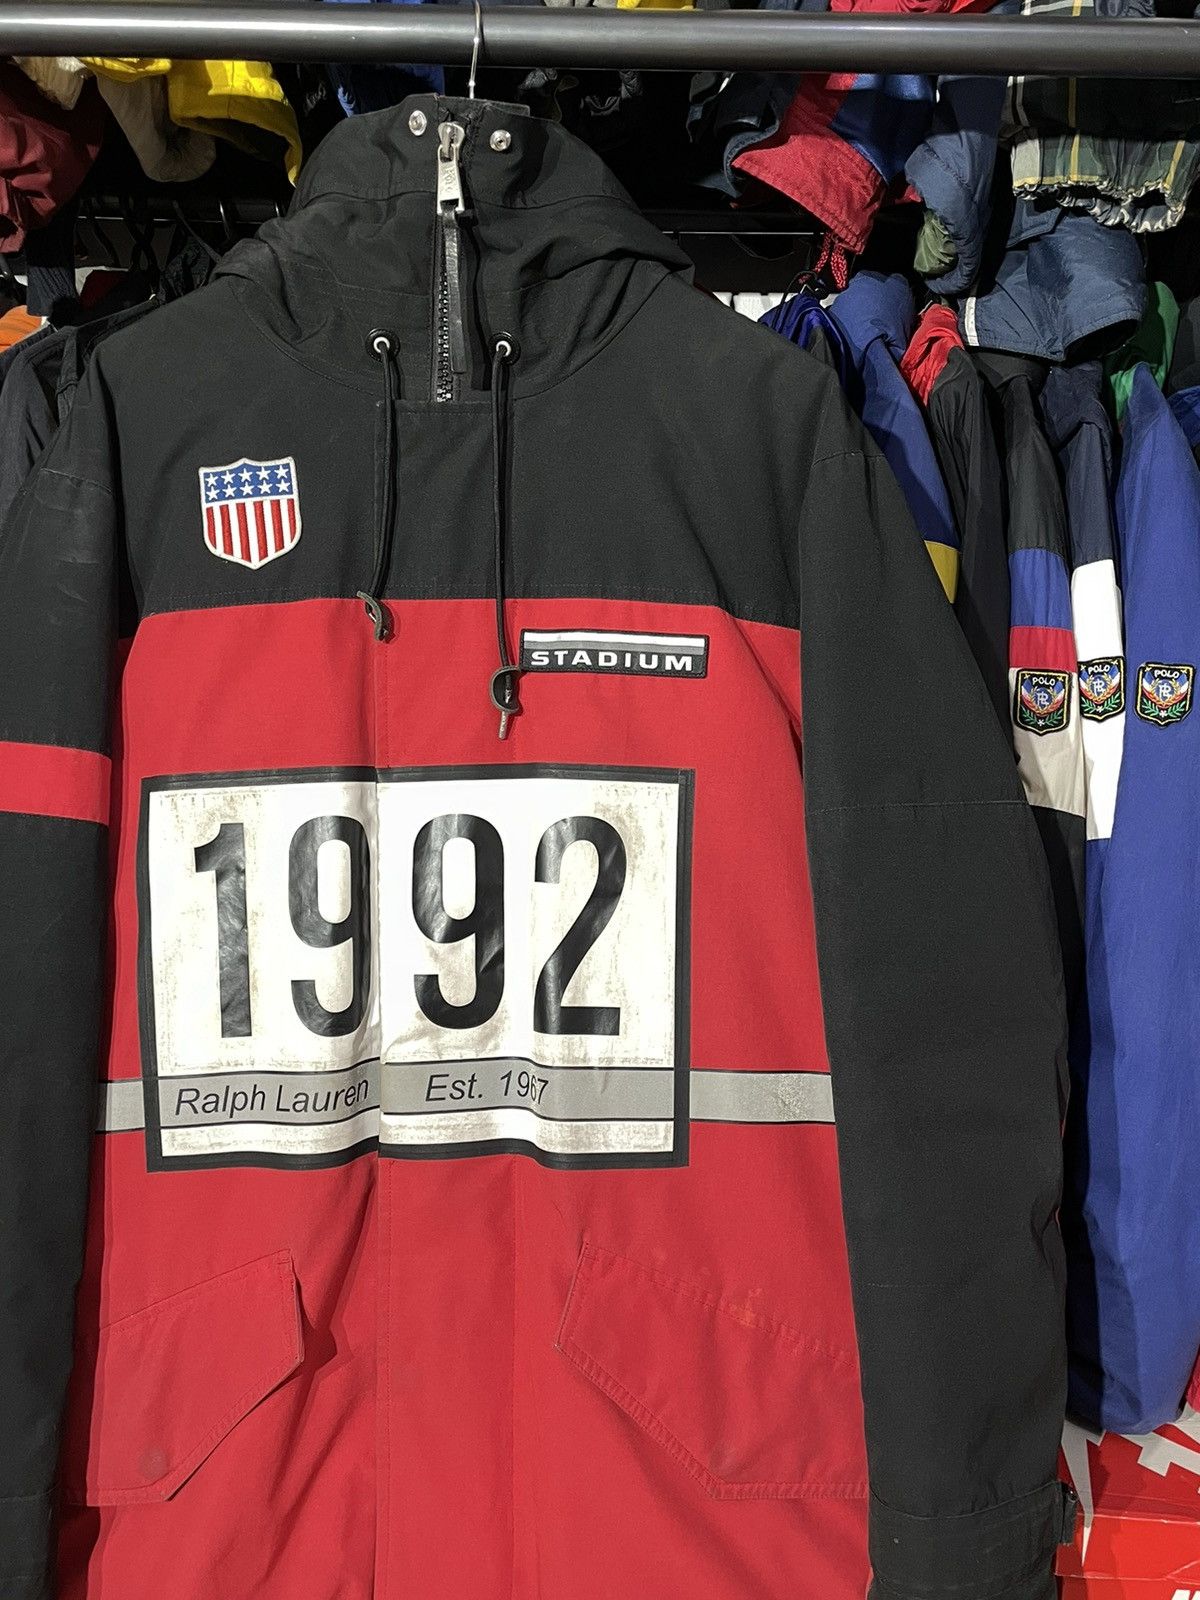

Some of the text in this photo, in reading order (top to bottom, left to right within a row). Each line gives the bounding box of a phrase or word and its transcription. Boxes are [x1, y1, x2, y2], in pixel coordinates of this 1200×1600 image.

[530, 650, 693, 672] STADIUM
[1087, 664, 1110, 675] POLO
[1154, 669, 1180, 679] POLO
[1032, 677, 1056, 686] POLO
[193, 812, 628, 1039] 1992
[174, 1070, 549, 1118] Ralph Lauren Est. 1967
